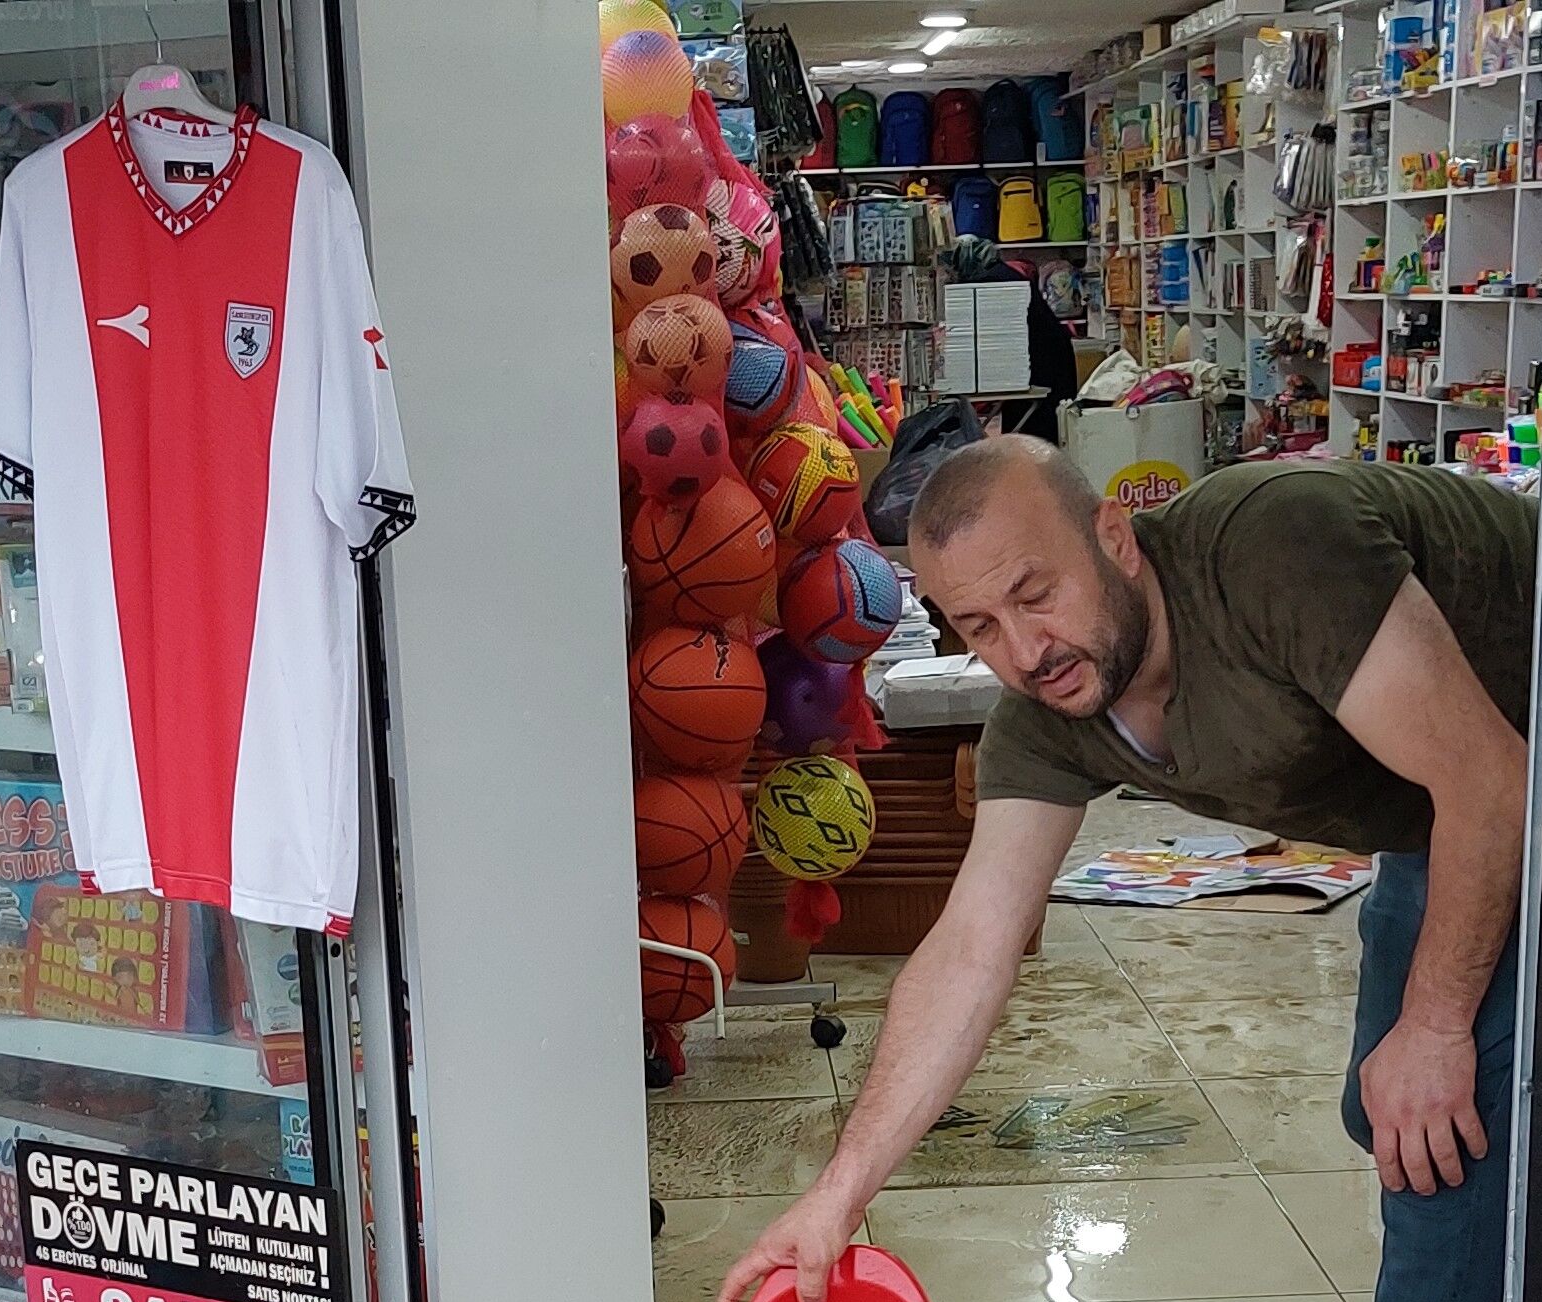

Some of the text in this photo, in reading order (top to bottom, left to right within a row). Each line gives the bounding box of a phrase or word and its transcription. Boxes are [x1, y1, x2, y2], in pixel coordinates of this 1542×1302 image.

[27, 1151, 328, 1236] GECE PARLAYAN
[30, 1194, 200, 1268] DÖVME
[207, 1228, 251, 1252] LÜTFEN
[256, 1236, 314, 1263] KUTULARI
[210, 1252, 317, 1287] AÇMADAN SEÇİNİZ
